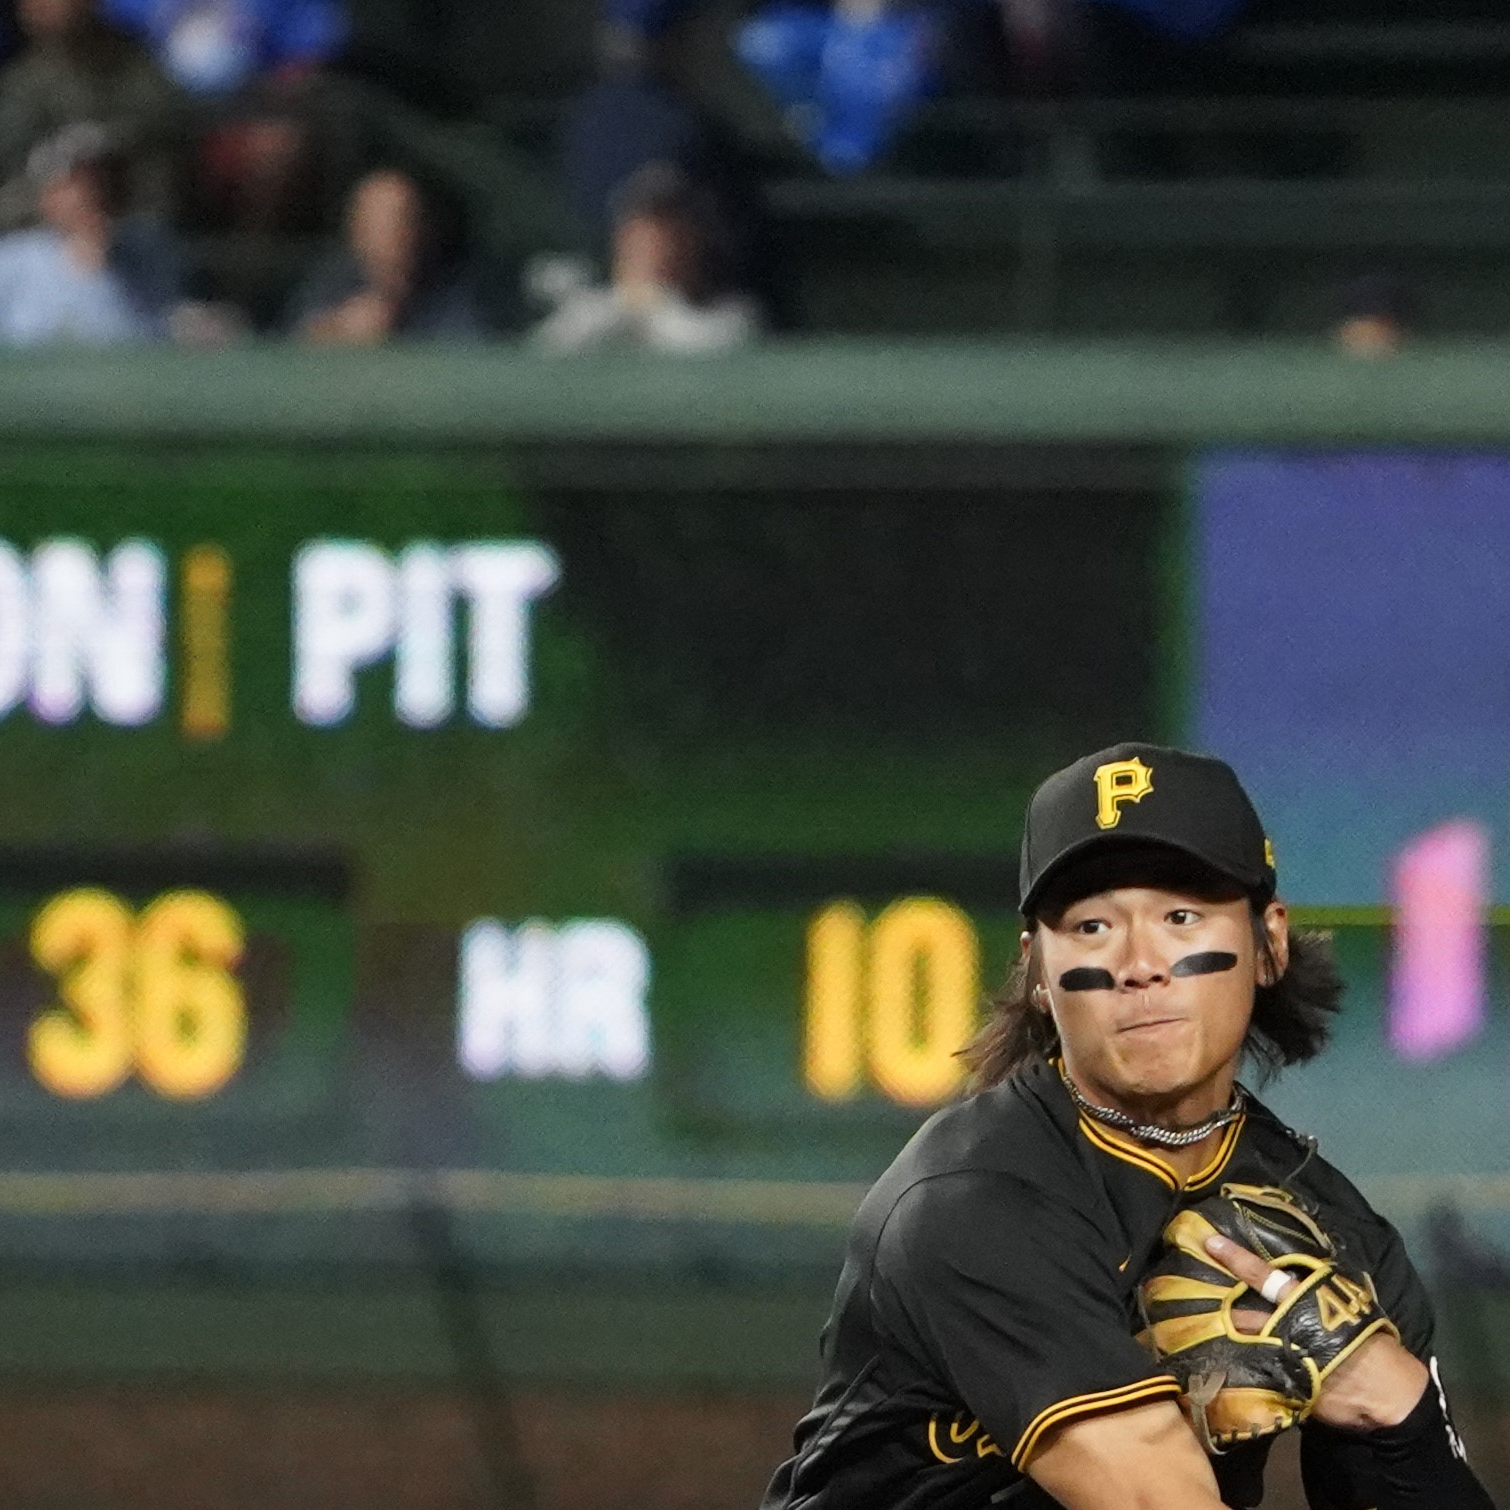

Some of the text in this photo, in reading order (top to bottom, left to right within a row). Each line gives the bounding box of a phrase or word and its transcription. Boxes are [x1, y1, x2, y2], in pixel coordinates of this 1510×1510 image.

[292, 541, 557, 726] PIT
[1094, 756, 1154, 830] P
[27, 889, 247, 1100] 36
[458, 919, 651, 1081] HR
[802, 898, 979, 1107] 10
